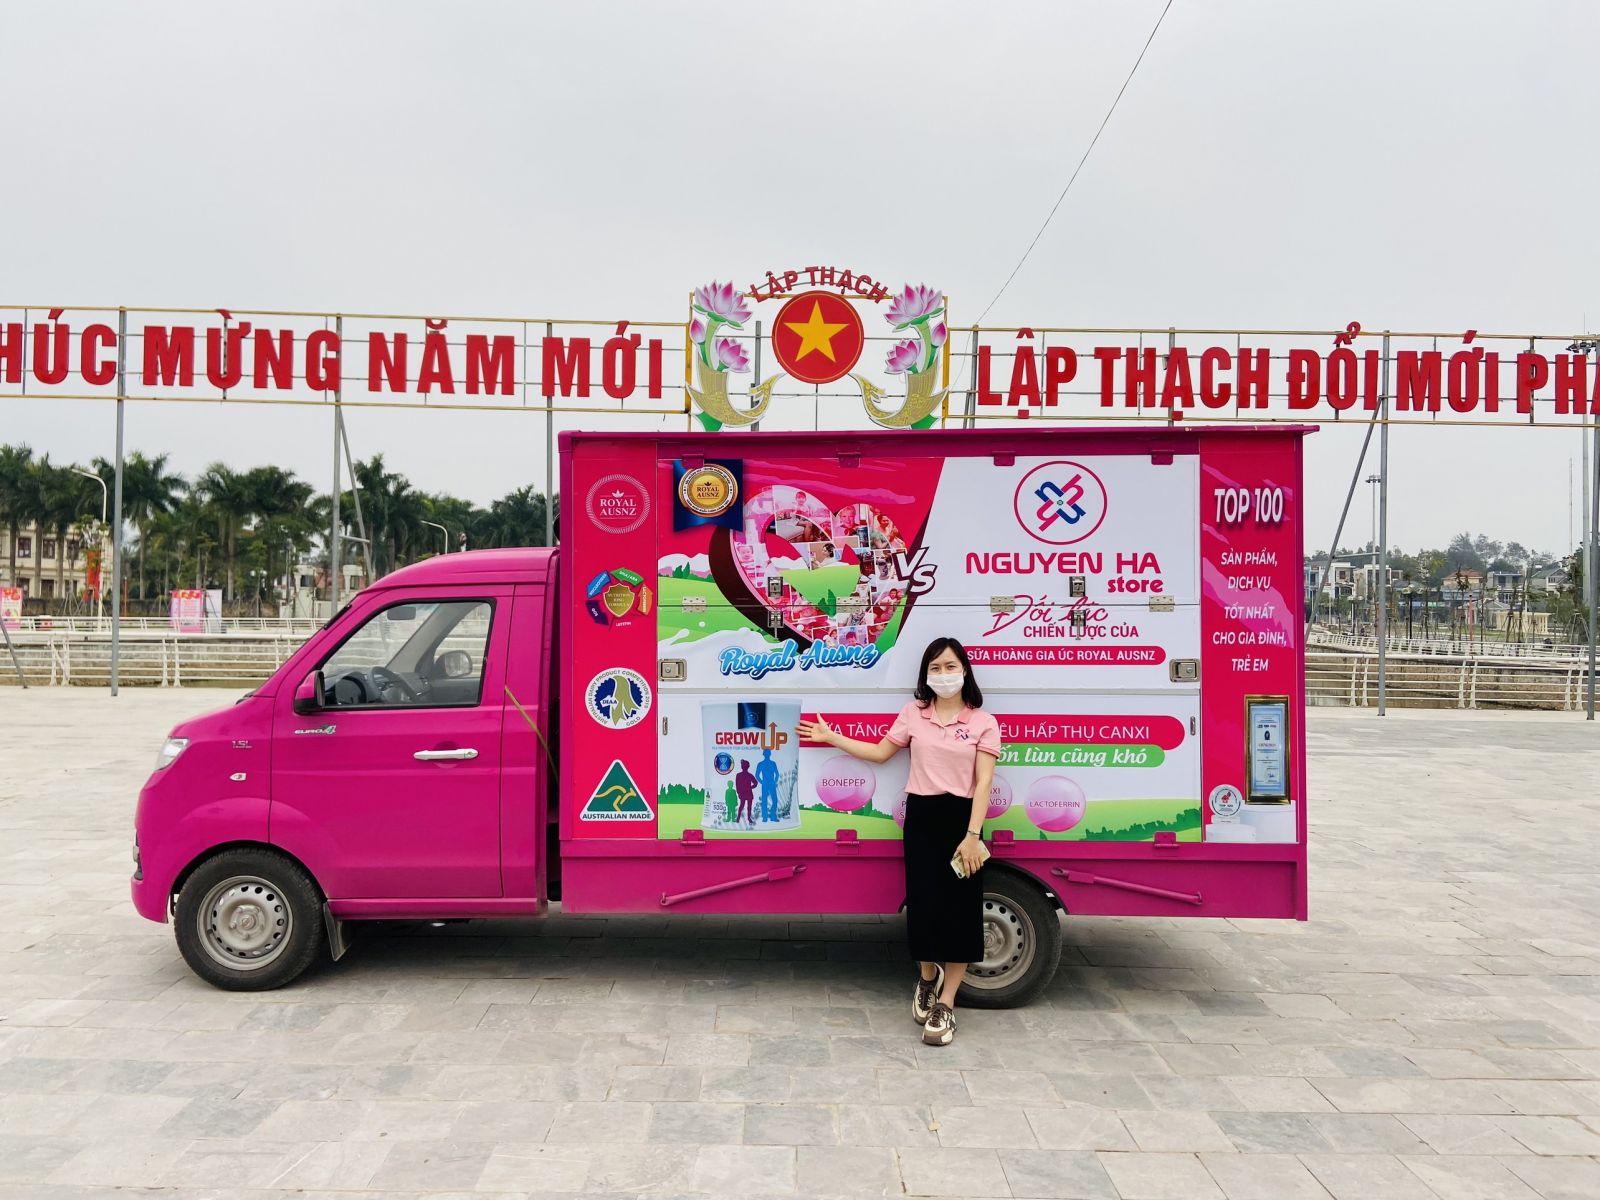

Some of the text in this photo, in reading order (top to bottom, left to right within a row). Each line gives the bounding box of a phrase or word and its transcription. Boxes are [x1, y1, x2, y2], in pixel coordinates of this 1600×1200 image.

[805, 266, 888, 304] THẠCH
[142, 308, 340, 391] MỪNG
[368, 318, 516, 395] NĂM
[541, 320, 663, 400] MỚI
[977, 328, 1078, 419] LẬP
[1093, 346, 1271, 421] THẠCH
[1286, 321, 1379, 412] ĐỔI
[1395, 329, 1499, 414] MỚI
[600, 499, 637, 507] ROYAL
[1214, 487, 1284, 523] TOP 100
[600, 508, 637, 516] AUSNZ
[965, 552, 1161, 574] NGUYEN HA
[1220, 547, 1278, 567] SẢN PHẨM,
[893, 547, 938, 595] VS
[1107, 576, 1164, 593] store
[1227, 576, 1271, 592] DỊCH VỤ
[1224, 601, 1275, 619] TỐT NHẤT
[1023, 623, 1065, 638] CHIẾN
[1110, 622, 1139, 638] CỦA
[1212, 631, 1237, 645] CHO
[1238, 631, 1257, 645] GIA
[719, 639, 880, 680] Royal Ausnz
[967, 647, 1156, 661] SỮA HOÀNG GIA ÚC ROYAL AUSNZ
[1231, 654, 1269, 671] TRẺ EM
[595, 669, 621, 682] PRODUCT
[626, 715, 641, 727] GOLD
[1024, 720, 1057, 738] HẤP
[1061, 725, 1095, 741] THỤ
[1099, 725, 1150, 739] CANXI
[1024, 746, 1056, 763] lùn
[1061, 748, 1107, 767] cũng
[1112, 747, 1148, 764] khó
[822, 778, 866, 787] BONEPEP
